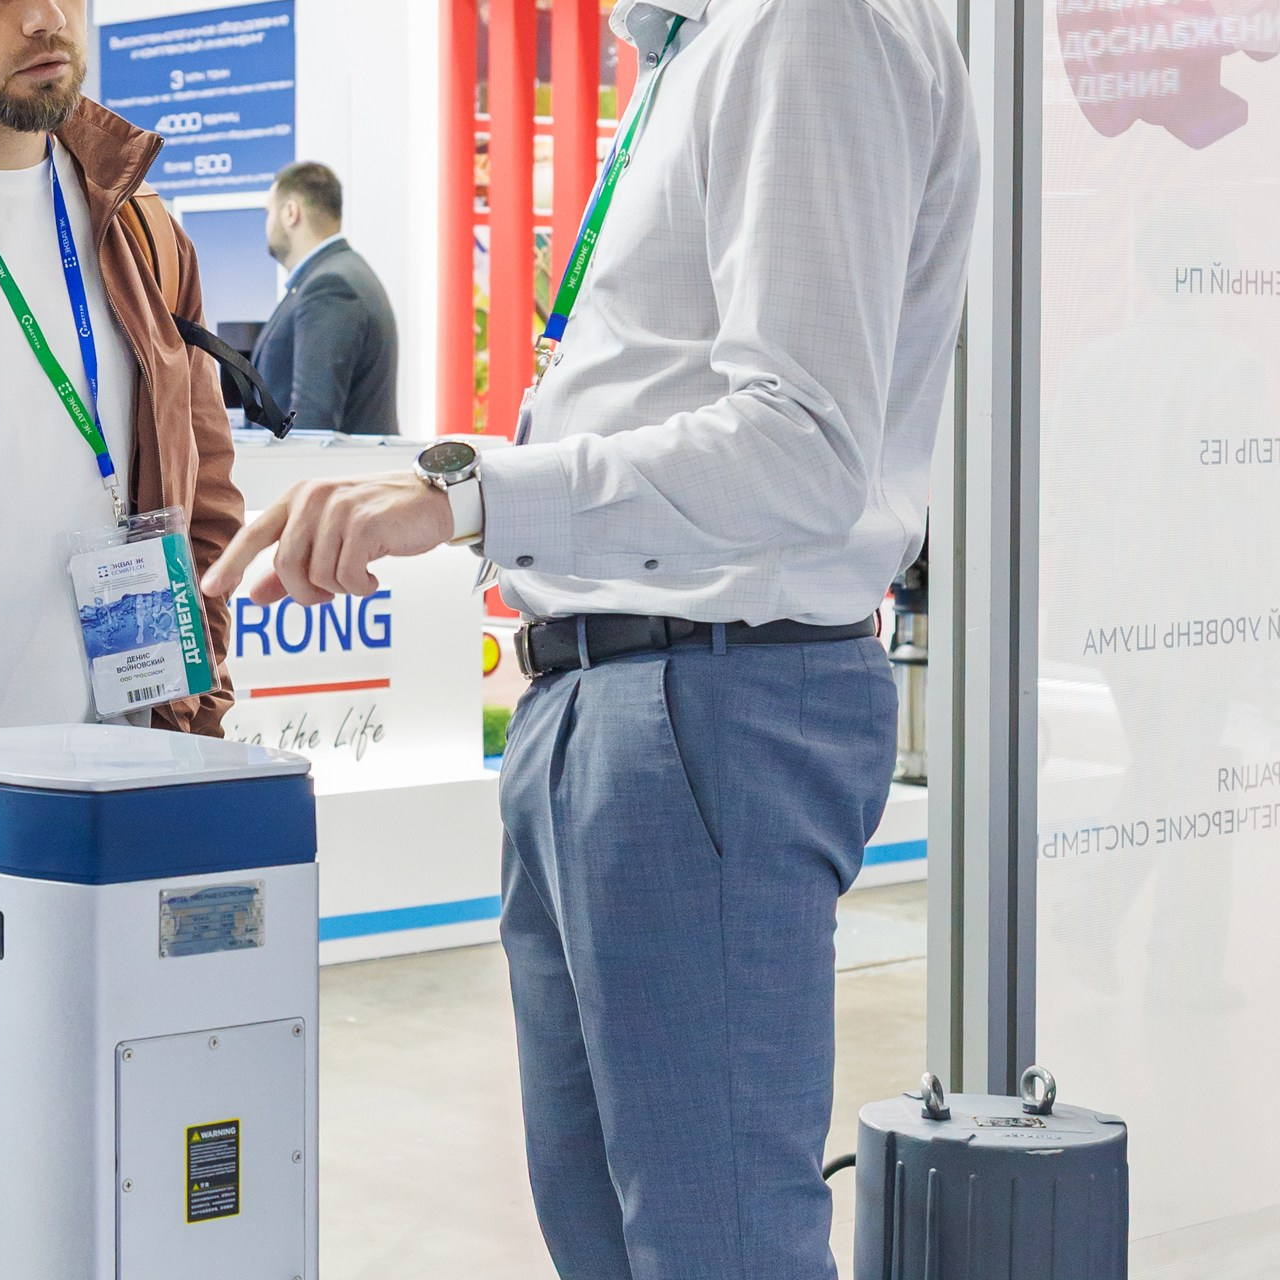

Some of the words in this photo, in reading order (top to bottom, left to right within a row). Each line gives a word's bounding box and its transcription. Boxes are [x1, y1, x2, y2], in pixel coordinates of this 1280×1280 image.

[567, 243, 590, 289] ЭКВАТЭК
[66, 395, 93, 435] ЭКВАТЭК
[173, 580, 202, 665] ДЕЛЕГАТ
[226, 589, 391, 658] RONG
[116, 657, 166, 674] ВОЙНОВСКИЙ
[126, 652, 151, 664] ДЕНИС
[278, 712, 321, 750] the
[334, 704, 386, 762] Life
[200, 1126, 237, 1139] WARNING
